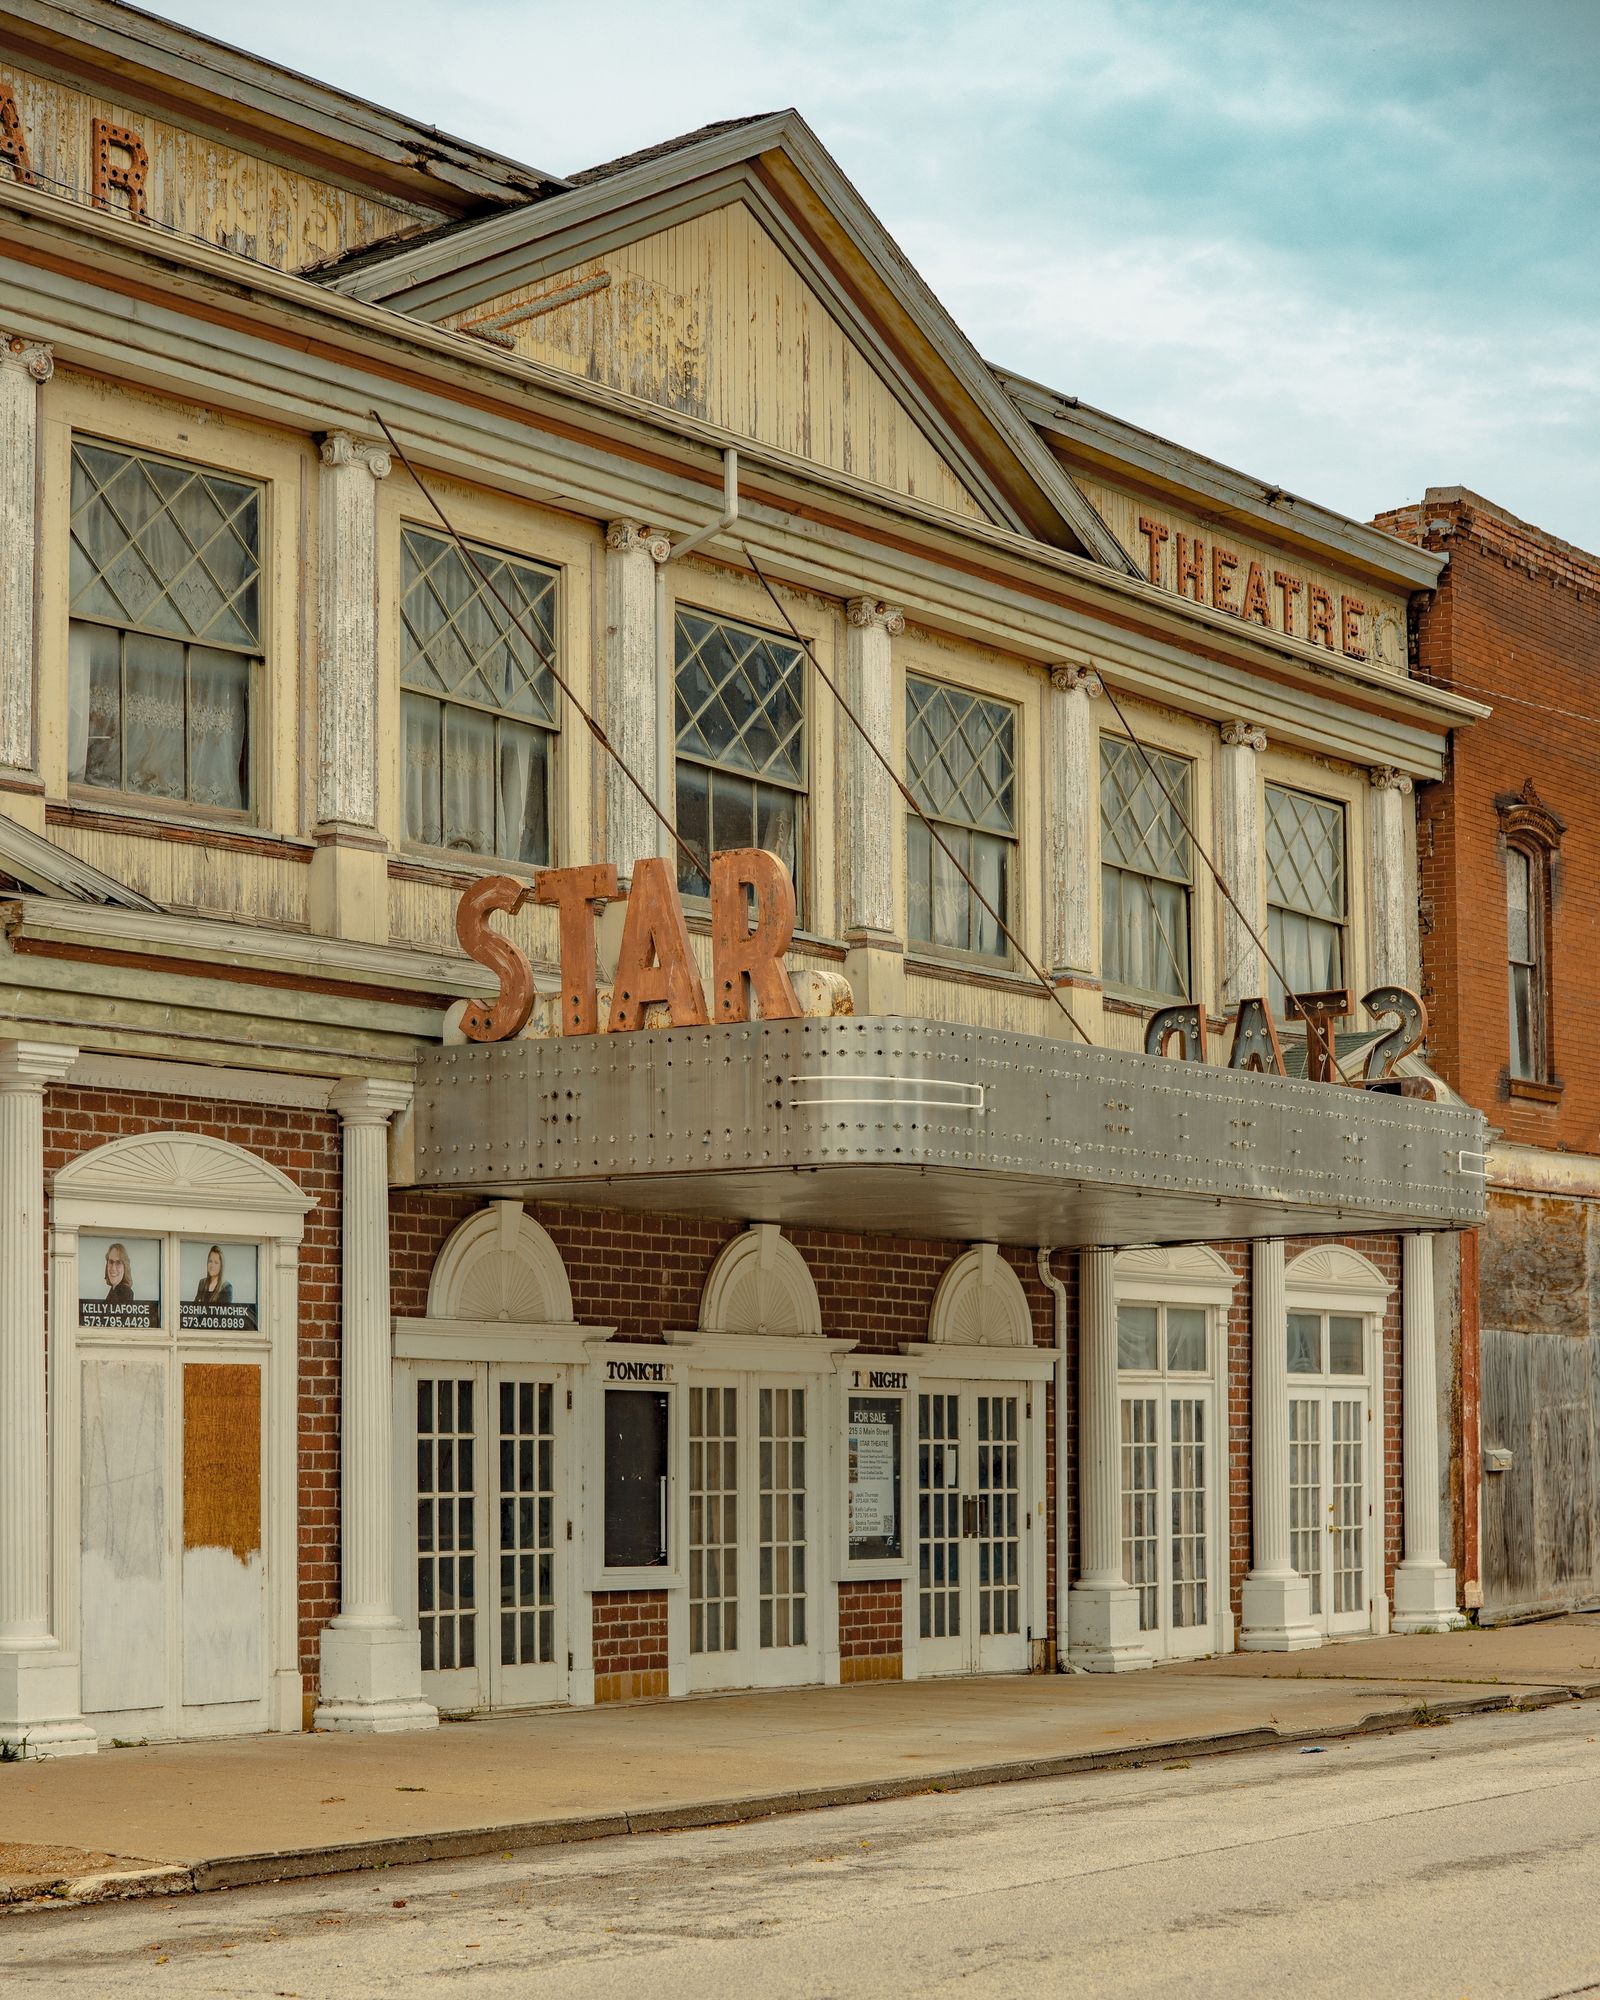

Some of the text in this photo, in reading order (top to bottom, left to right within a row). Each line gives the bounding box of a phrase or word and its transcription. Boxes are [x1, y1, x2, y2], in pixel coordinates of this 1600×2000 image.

[1139, 516, 1367, 662] THEATRE
[456, 847, 803, 1042] STAR
[82, 1303, 150, 1315] KELLY LAFORCE
[208, 1306, 249, 1316] TYMCHEK
[83, 1316, 150, 1328] 573.795.4429
[182, 1316, 245, 1329] 573.406.8989
[853, 1411, 886, 1423] FOR SALE
[849, 1427, 858, 1435] 215
[863, 1427, 876, 1435] Main
[876, 1428, 890, 1436] Street
